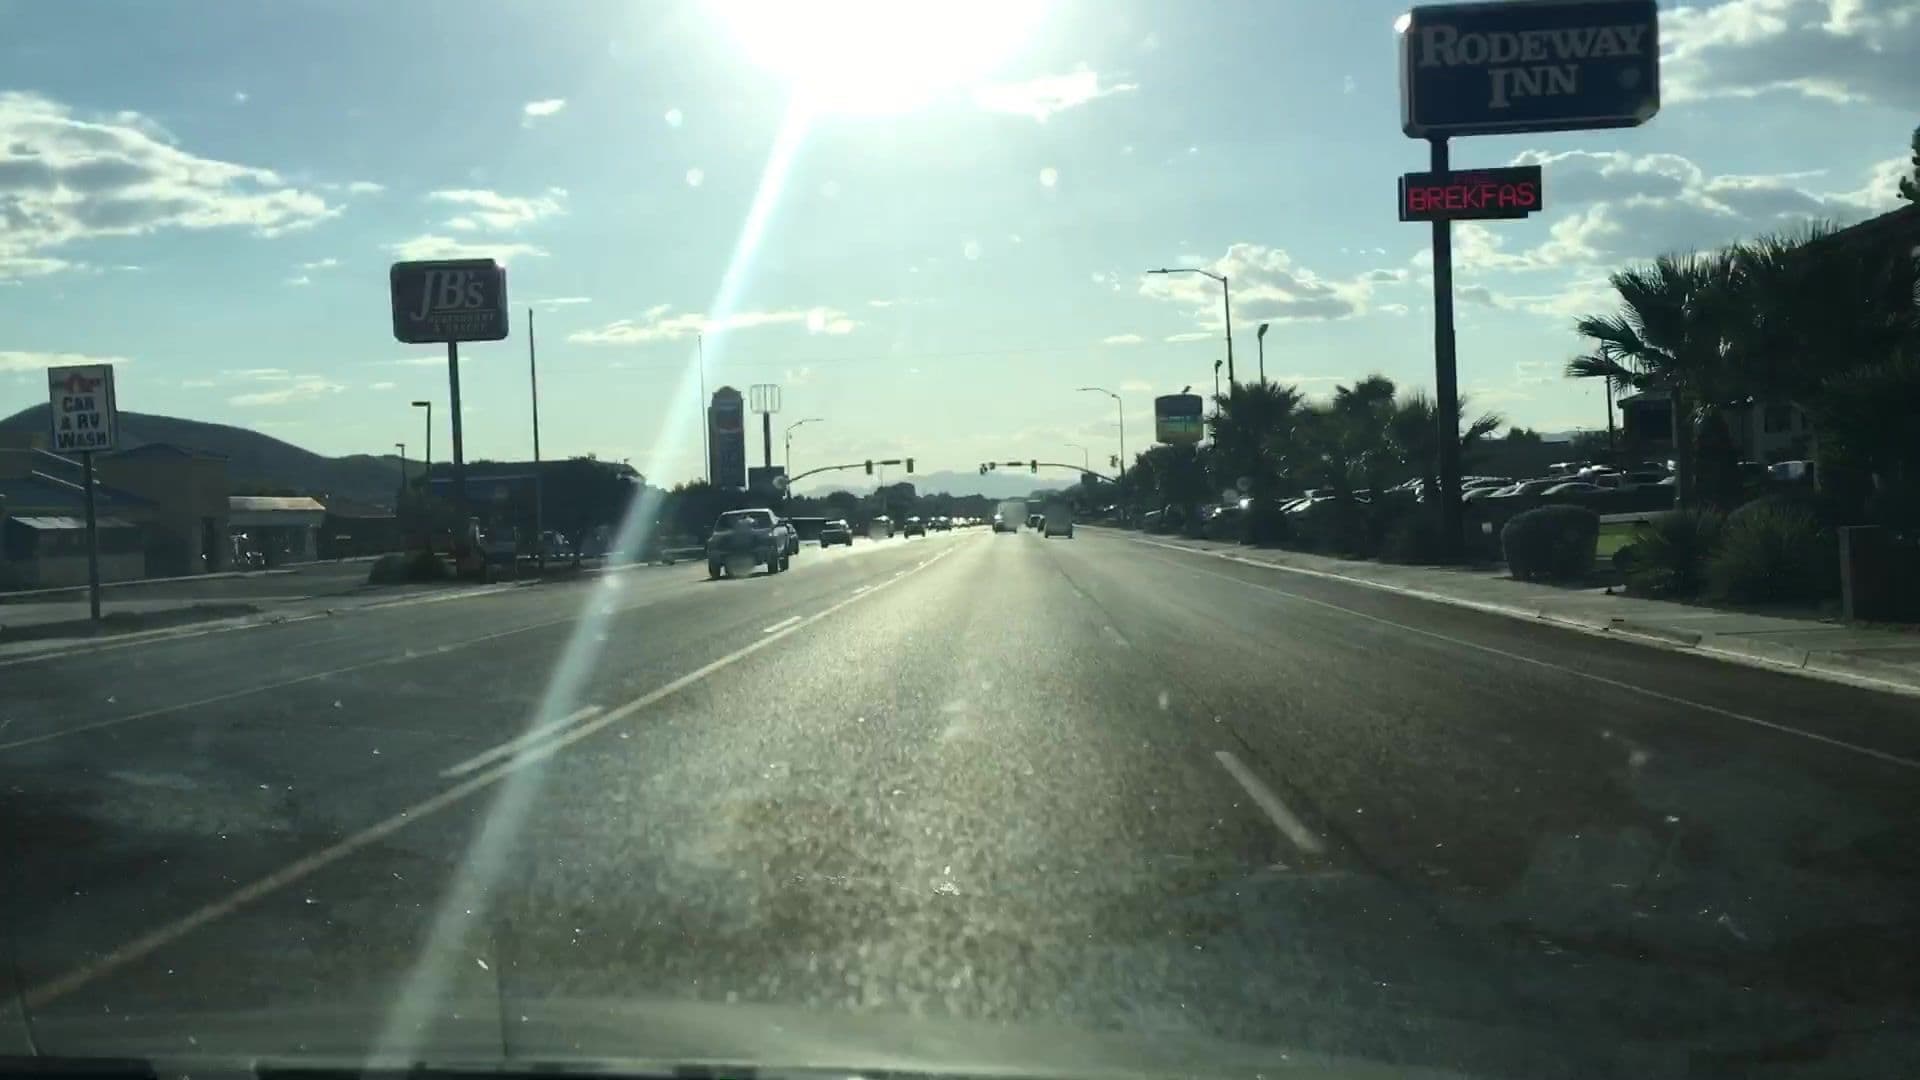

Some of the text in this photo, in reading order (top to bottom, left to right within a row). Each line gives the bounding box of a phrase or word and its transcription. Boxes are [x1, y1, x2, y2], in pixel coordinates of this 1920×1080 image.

[1418, 23, 1648, 68] RODEWAY
[1488, 63, 1579, 109] INN
[1408, 183, 1537, 211] BREKFAS
[63, 396, 95, 412] CAR
[77, 412, 99, 429] RV
[57, 431, 107, 448] WASH
